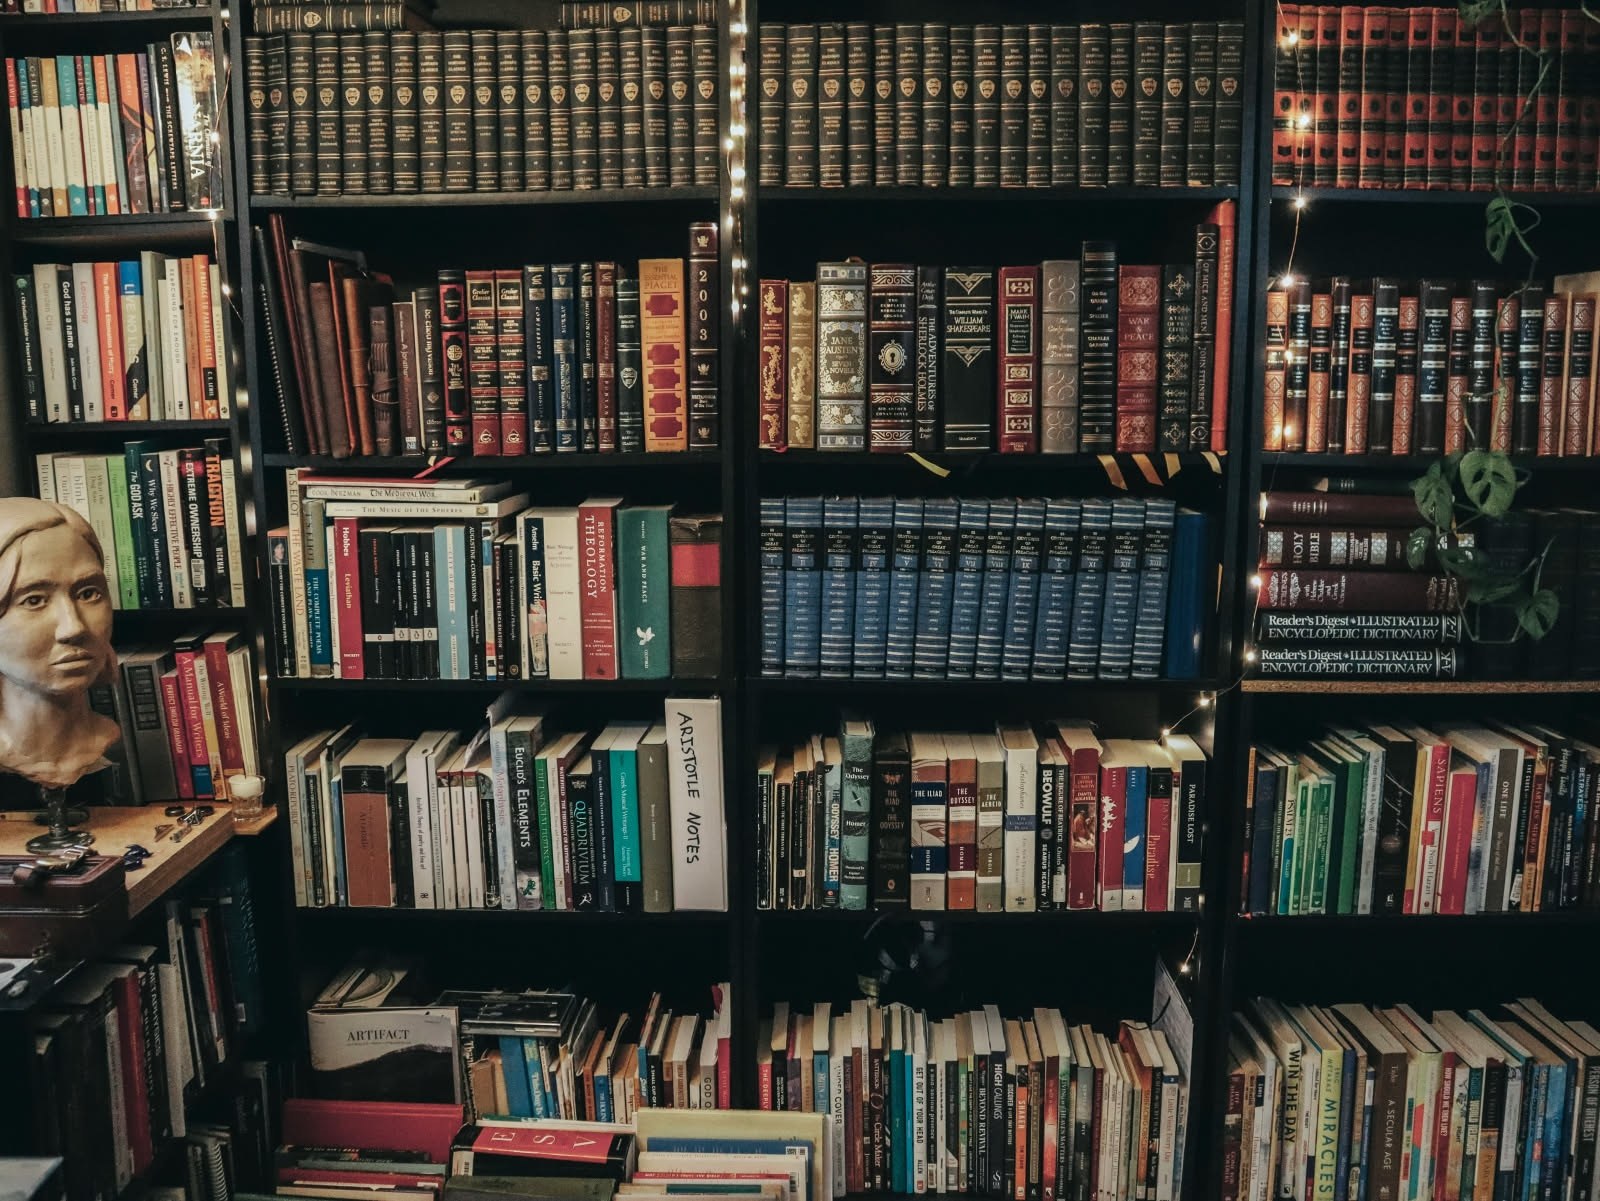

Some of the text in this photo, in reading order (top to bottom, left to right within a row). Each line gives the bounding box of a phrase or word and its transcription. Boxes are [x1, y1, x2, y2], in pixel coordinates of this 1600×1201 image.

[62, 281, 71, 299] God
[644, 281, 679, 289] PIAGET
[64, 301, 72, 316] has
[1128, 317, 1150, 326] WAR
[67, 325, 75, 349] name
[946, 324, 991, 333] SHAKESPEARE
[1124, 333, 1154, 341] PEACE
[831, 346, 863, 354] AUSTEN
[917, 317, 927, 412] SHERLOCK HOLMES
[927, 317, 937, 411] THE ADVENTURES OF
[130, 471, 144, 520] The GOD ASK
[148, 479, 159, 532] Why We Sleep
[206, 454, 225, 527] TRACTION
[185, 462, 203, 558] EXTREME OWNERSHIP
[166, 484, 183, 571] HIGHLY EFFECTIVE PEOPLE
[531, 526, 541, 582] Anselm Basic
[585, 515, 598, 598] THEOLOGY
[597, 521, 608, 593] REFORMATION
[640, 545, 648, 562] WAR
[1293, 531, 1304, 564] HOLY
[1310, 531, 1320, 563] BIBLE
[342, 527, 353, 609] Hobbes Leviathan
[641, 583, 649, 604] PEACE
[1268, 615, 1440, 630] Reader's Digest ILLUSTRATED
[1268, 628, 1440, 640] ENCYCLOPEDIC DICTIONARY
[1261, 649, 1433, 663] Reader's Digest ILLUSTRATED
[1261, 662, 1432, 674] ENCYCLOPEDIC DICTIONARY
[1440, 651, 1452, 672] A-K
[184, 668, 199, 704] Manual
[189, 704, 202, 721] for
[191, 722, 205, 758] Writers
[677, 711, 702, 864] ARISTOTLE NOTES
[845, 773, 870, 781] Odyssey
[1432, 758, 1448, 814] SAPIENS
[513, 746, 531, 848] EUCLID'S ELEMENTS
[950, 796, 976, 805] ODYSSEY
[1041, 769, 1053, 825] BEOWULF
[1285, 799, 1297, 827] PSALM
[1499, 780, 1510, 819] ONE LIFE
[830, 802, 840, 839] ODYSSEY
[1186, 783, 1197, 844] PARADISE LOST
[574, 800, 590, 885] QUADRIVIUM
[829, 848, 840, 882] HOMER
[347, 1030, 410, 1041] ARTIFACT
[703, 1077, 712, 1098] GOD
[915, 1066, 925, 1079] GET
[915, 1082, 925, 1095] OUT
[1587, 1065, 1600, 1095] PERSON
[993, 1063, 1004, 1120] HIGH CALLINGS
[1283, 1049, 1302, 1143] WIN THE DAY
[834, 1096, 843, 1125] COVER
[916, 1106, 925, 1124] YOUR
[978, 1087, 987, 1153] BEYOND REVIVAL
[1583, 1107, 1597, 1142] INTEREST
[916, 1126, 925, 1144] HEAD
[1384, 1109, 1396, 1148] SECULAR
[1319, 1097, 1339, 1193] MIRACLES
[1383, 1151, 1393, 1170] AGE
